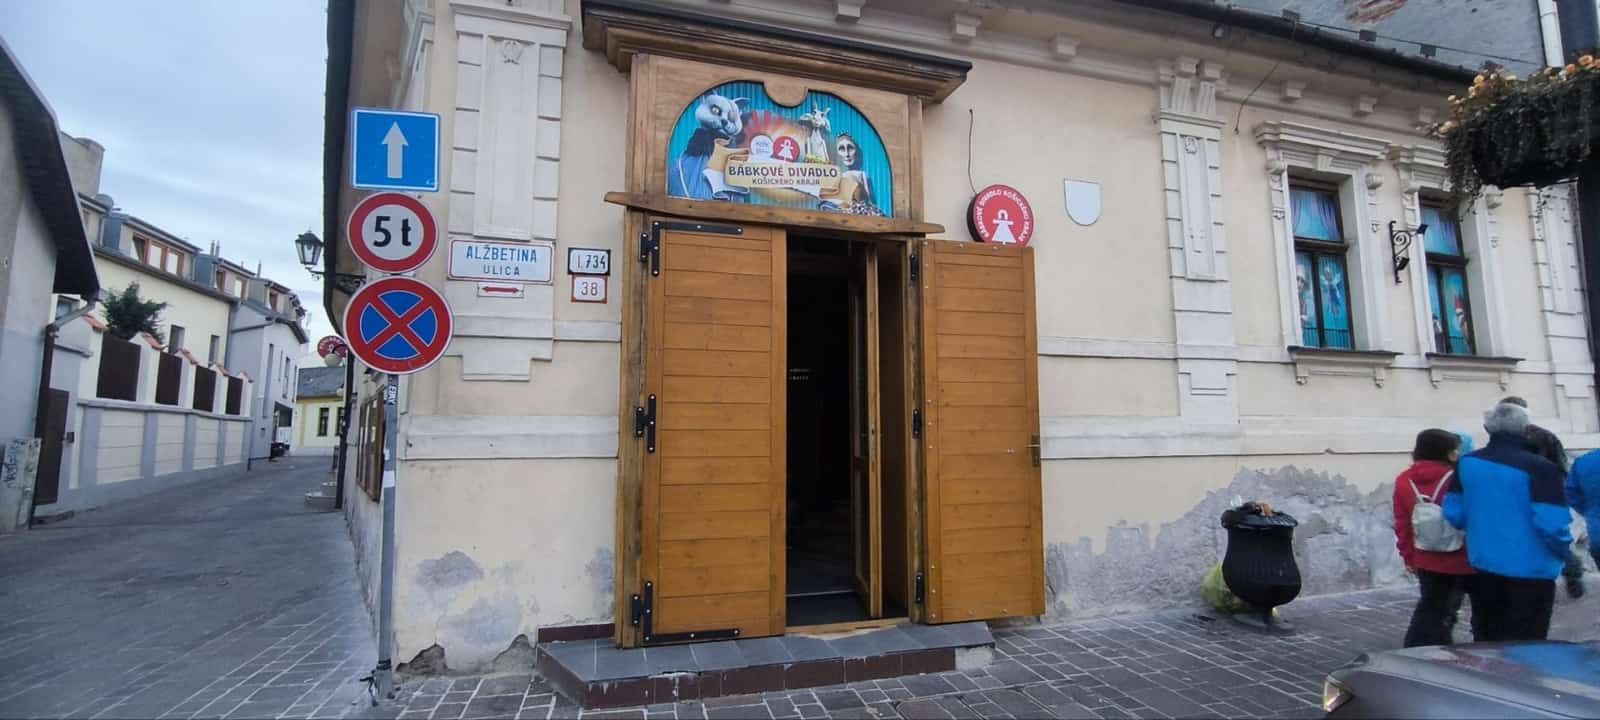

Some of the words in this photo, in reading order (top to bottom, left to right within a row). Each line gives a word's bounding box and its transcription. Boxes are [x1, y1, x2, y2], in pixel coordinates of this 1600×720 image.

[788, 166, 838, 178] DIVADLO
[373, 215, 392, 248] 5
[401, 218, 412, 247] t
[466, 244, 537, 263] ALŽBETINA
[483, 264, 520, 276] ULICA
[581, 281, 598, 296] 38
